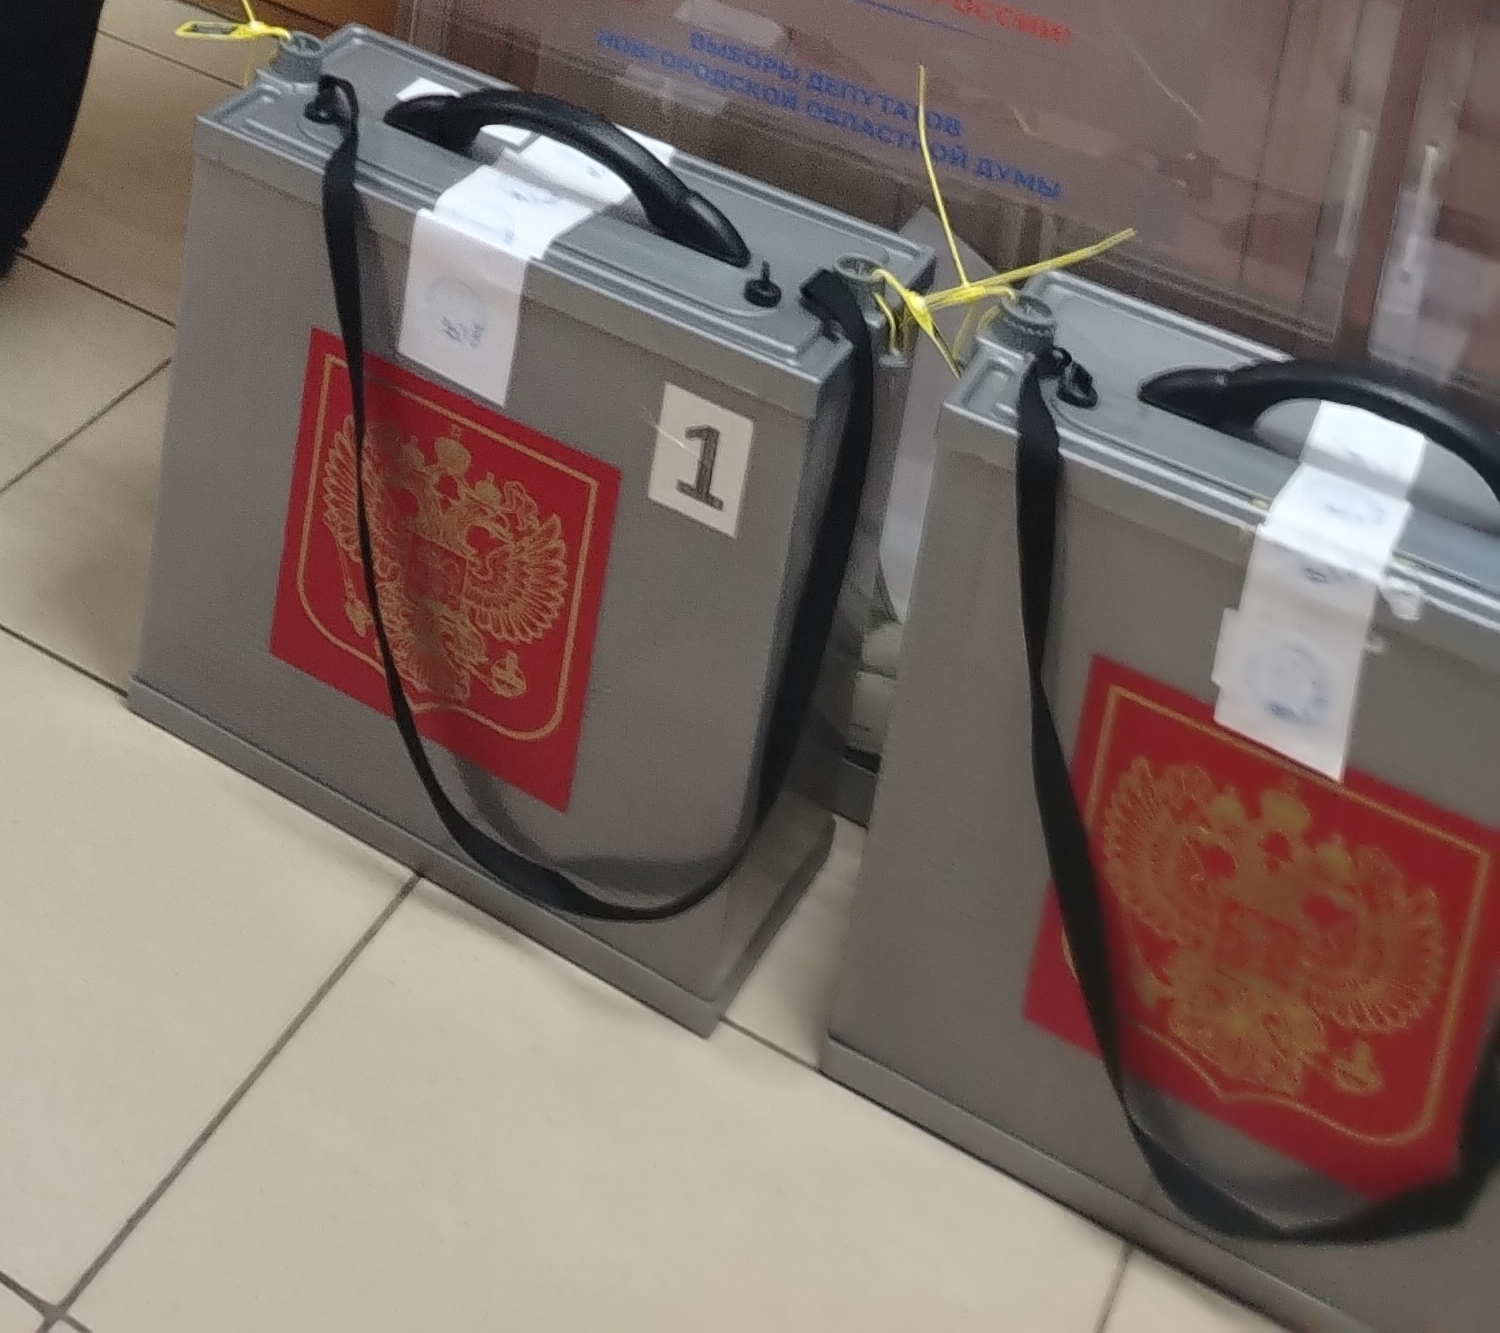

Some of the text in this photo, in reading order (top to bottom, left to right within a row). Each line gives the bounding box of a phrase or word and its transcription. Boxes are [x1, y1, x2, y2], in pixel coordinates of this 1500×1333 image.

[690, 31, 799, 81] ВЫБОРЫ
[596, 31, 798, 110] НОВГОРОДСКОЙ
[974, 157, 1062, 201] ДУМЫ
[676, 425, 725, 511] 1
